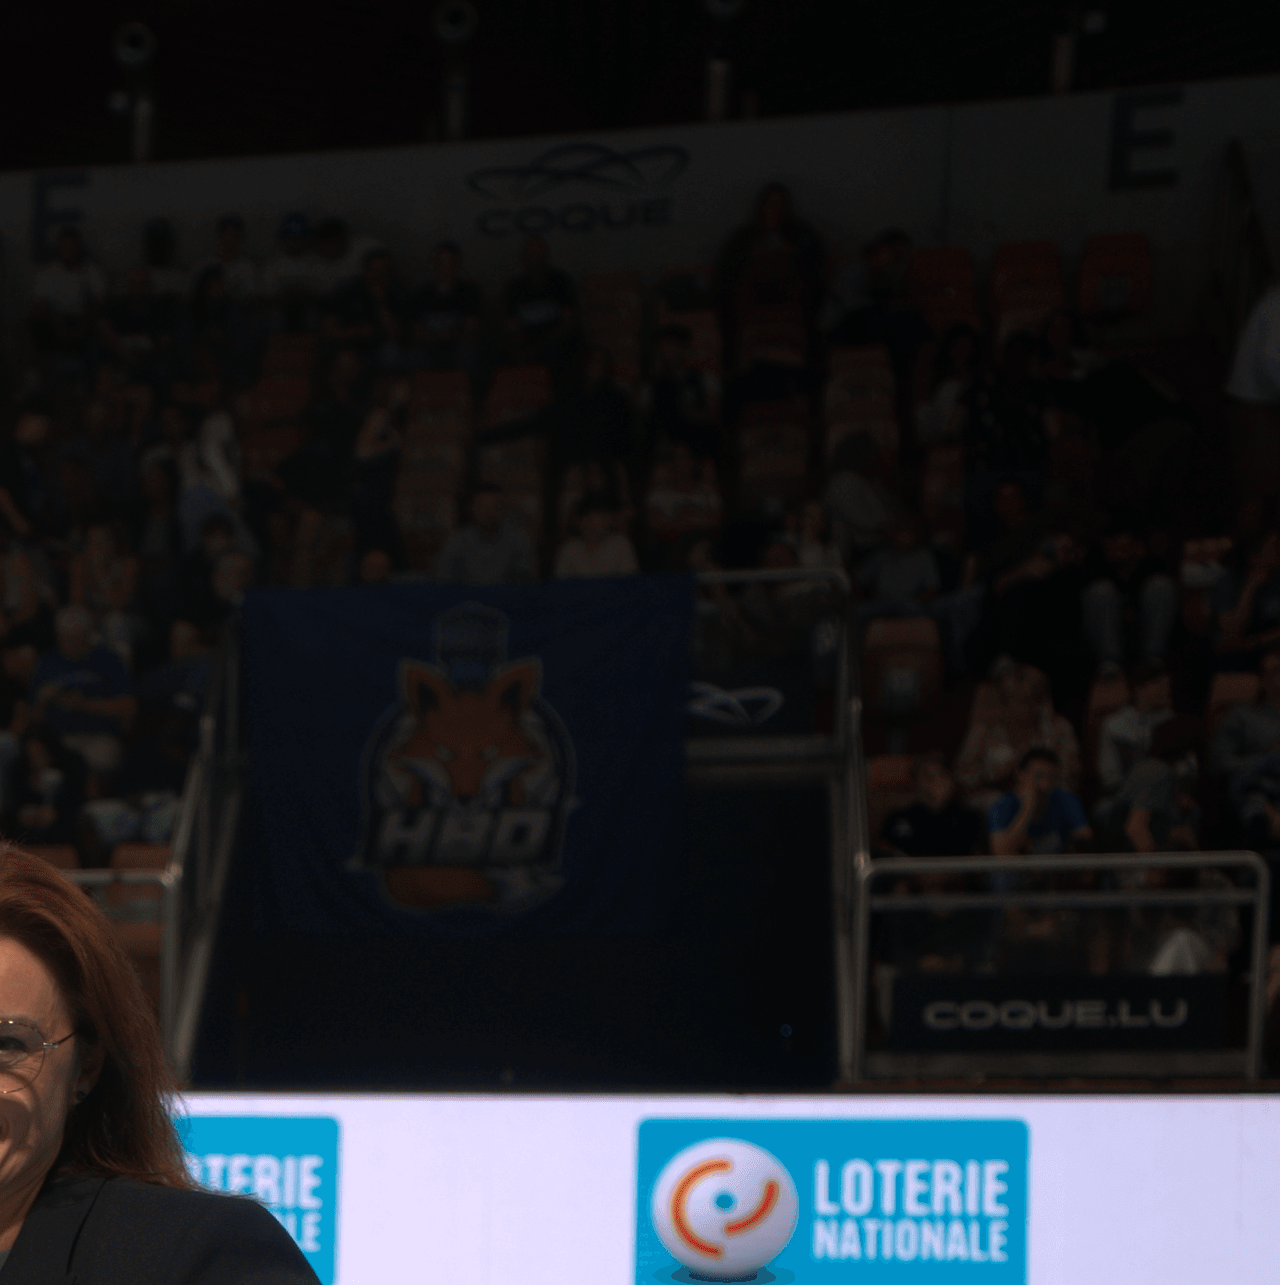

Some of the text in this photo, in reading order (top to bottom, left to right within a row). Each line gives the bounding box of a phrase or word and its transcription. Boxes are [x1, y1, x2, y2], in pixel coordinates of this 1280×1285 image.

[1108, 88, 1184, 190] E
[476, 199, 672, 237] COQUE
[922, 998, 1189, 1030] COQUE.LU
[184, 1153, 324, 1208] TERIE
[813, 1158, 1009, 1217] LOTERIE
[812, 1218, 1009, 1262] NATIONALE
